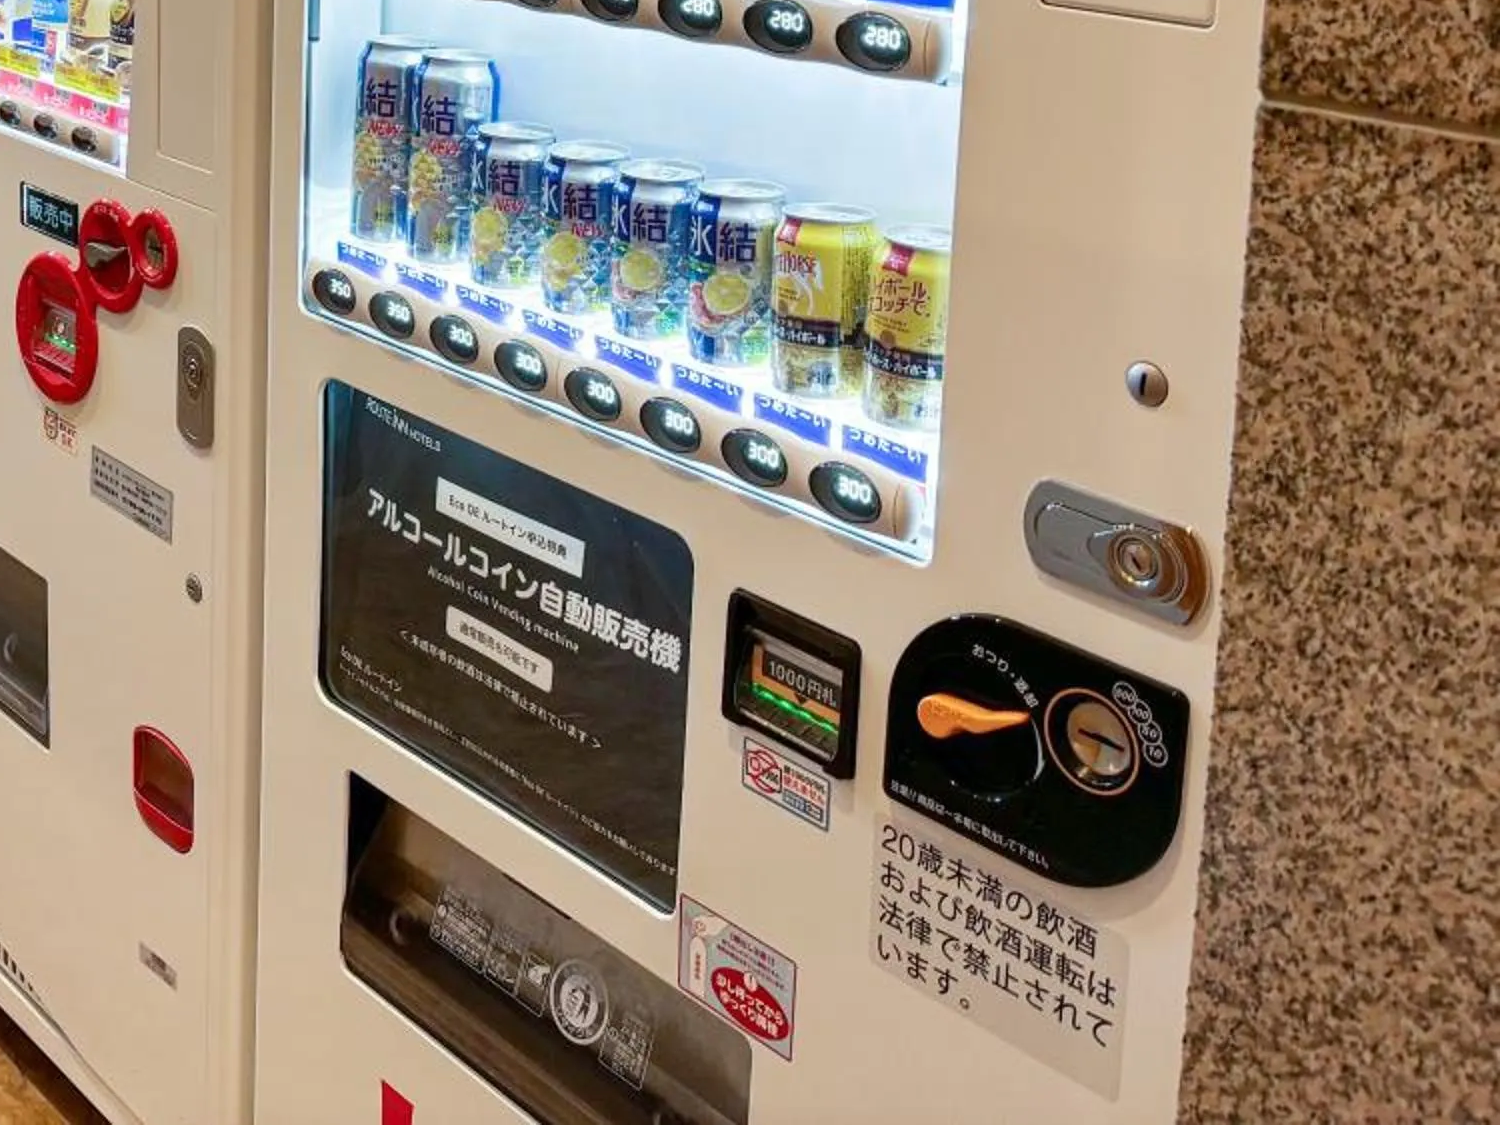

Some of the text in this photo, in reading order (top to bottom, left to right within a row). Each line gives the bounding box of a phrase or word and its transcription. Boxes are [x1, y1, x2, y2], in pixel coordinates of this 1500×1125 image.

[768, 9, 803, 33] 280
[862, 26, 901, 50] 280
[365, 78, 398, 117] 結
[421, 94, 457, 136] 結
[28, 194, 73, 240] 販売中
[690, 214, 757, 264] 氷結
[367, 487, 682, 674] アルコールコイン自動販売機
[533, 625, 580, 654] machine
[768, 659, 838, 707] 1000円札
[1142, 726, 1159, 740] 50
[881, 824, 1099, 959] 20歳未満の飲酒
[880, 860, 1117, 1008] および飲酒運転は
[877, 934, 971, 1010] います。
[878, 895, 1113, 1048] 法律で禁止されて
